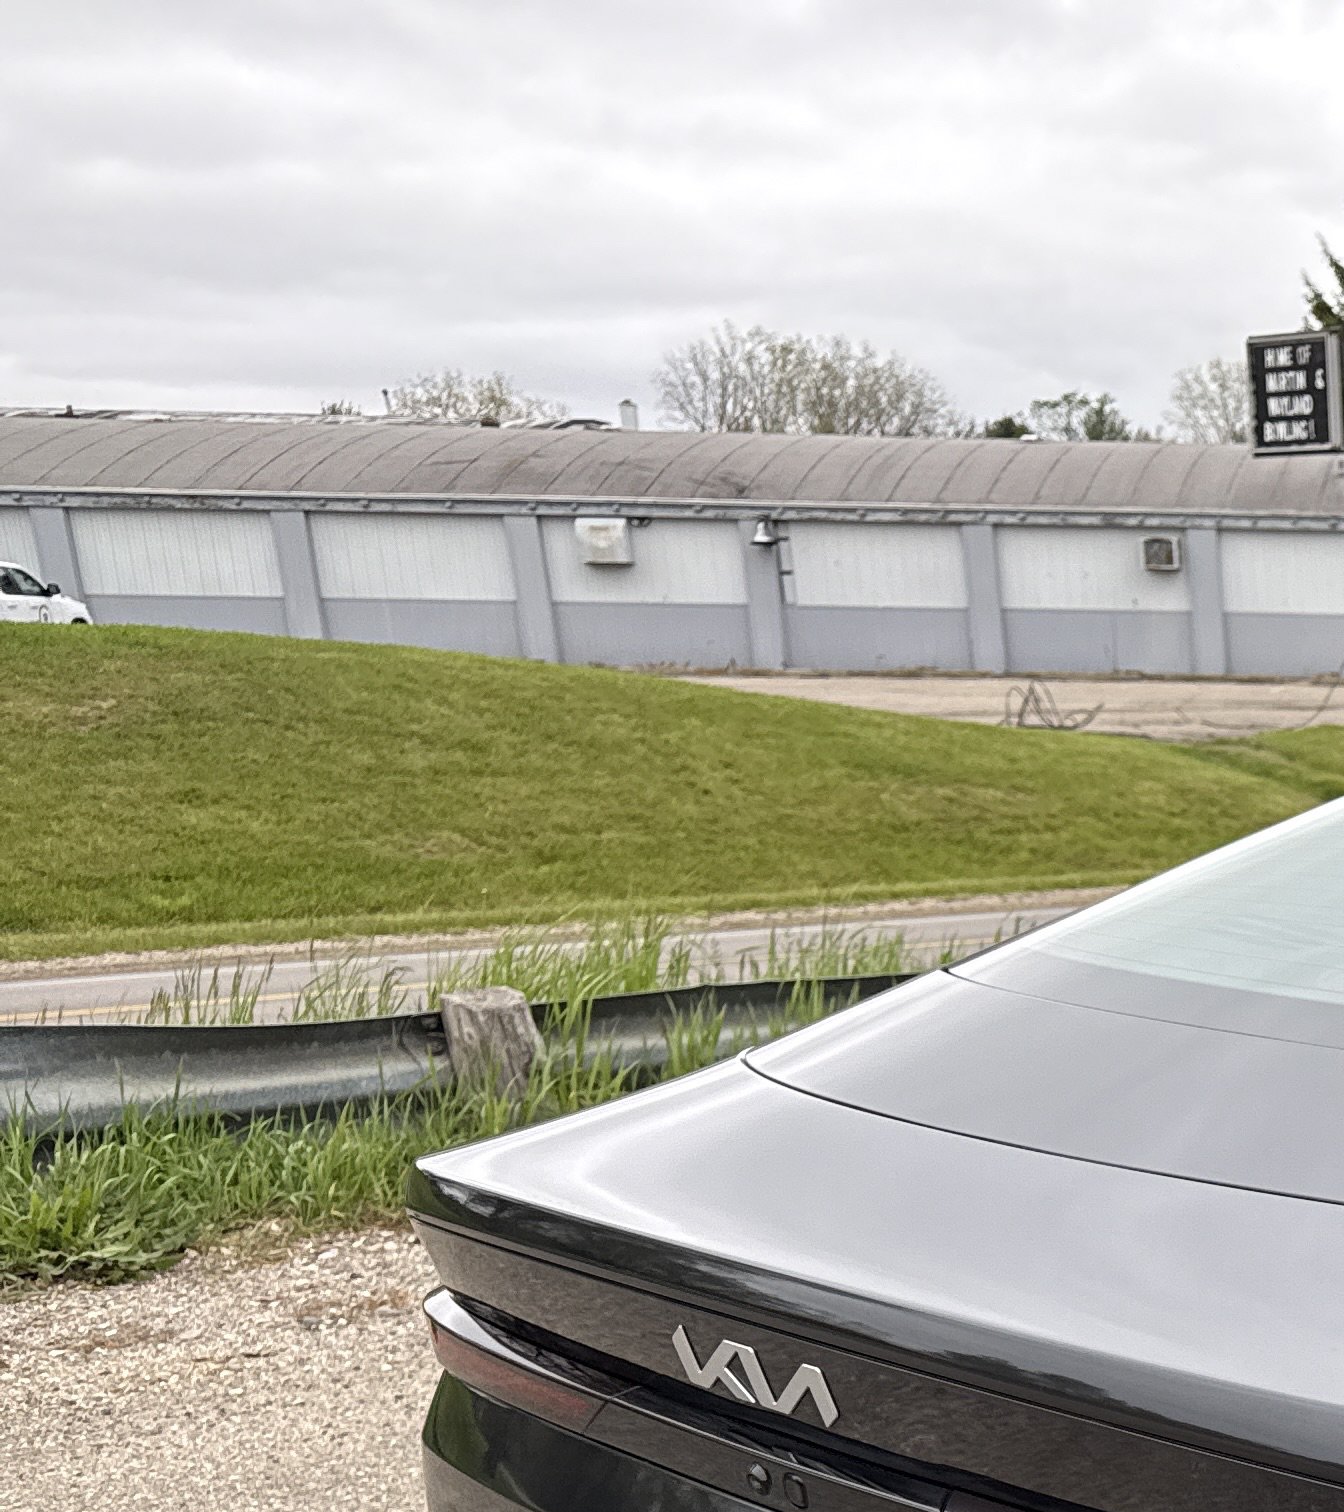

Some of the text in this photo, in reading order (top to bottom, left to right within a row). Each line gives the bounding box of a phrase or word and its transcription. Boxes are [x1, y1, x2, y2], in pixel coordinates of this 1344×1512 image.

[1296, 344, 1312, 366] OF
[1265, 368, 1326, 393] MARTIN &
[671, 1324, 840, 1429] KIA
